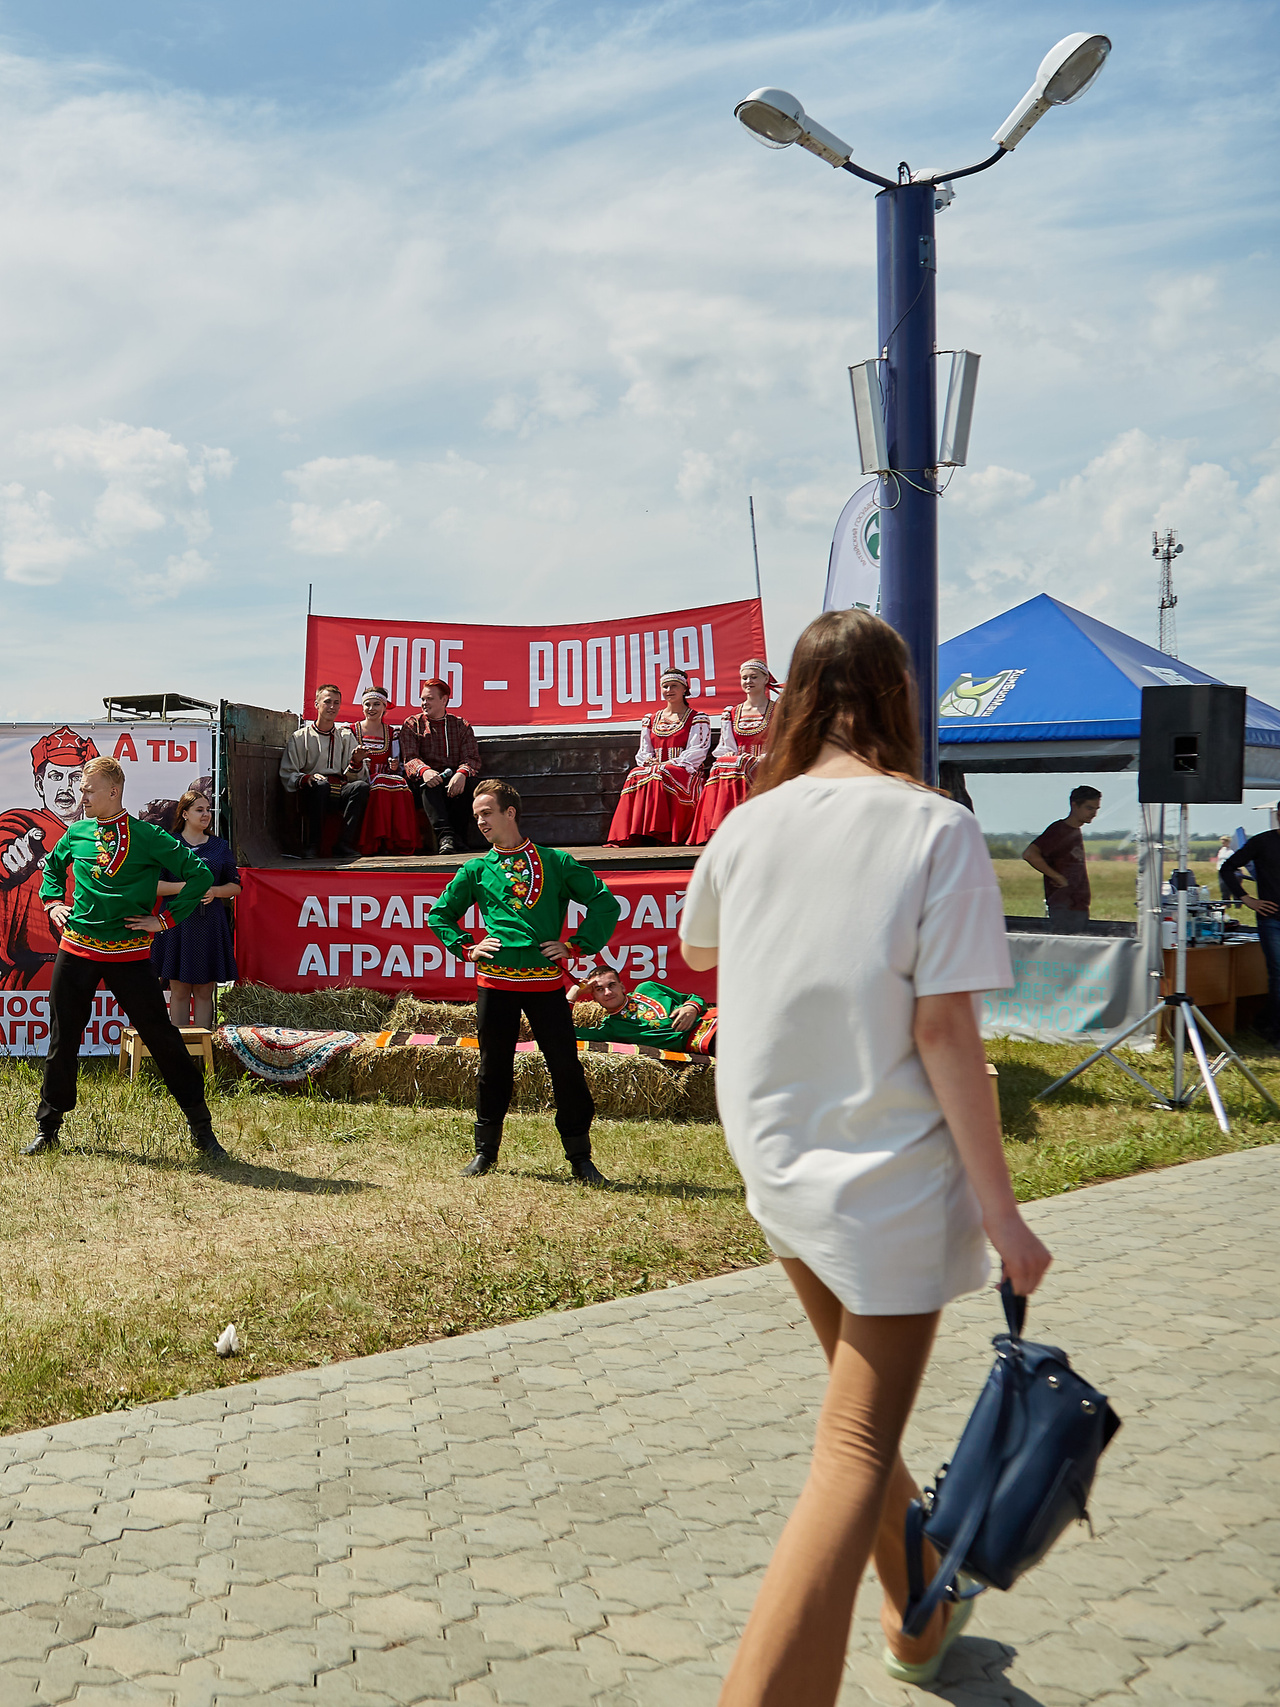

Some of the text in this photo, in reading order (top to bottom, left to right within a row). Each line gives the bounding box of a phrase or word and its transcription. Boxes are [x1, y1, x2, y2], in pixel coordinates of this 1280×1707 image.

[297, 895, 486, 929] АГРАР
[297, 943, 475, 978] АГРАРН
[1013, 960, 1110, 981] РСТВЕННЫЙ
[986, 982, 1107, 1004] ИВЕРСИТЕТ
[981, 1000, 1107, 1034] ОЛЗУНОВА
